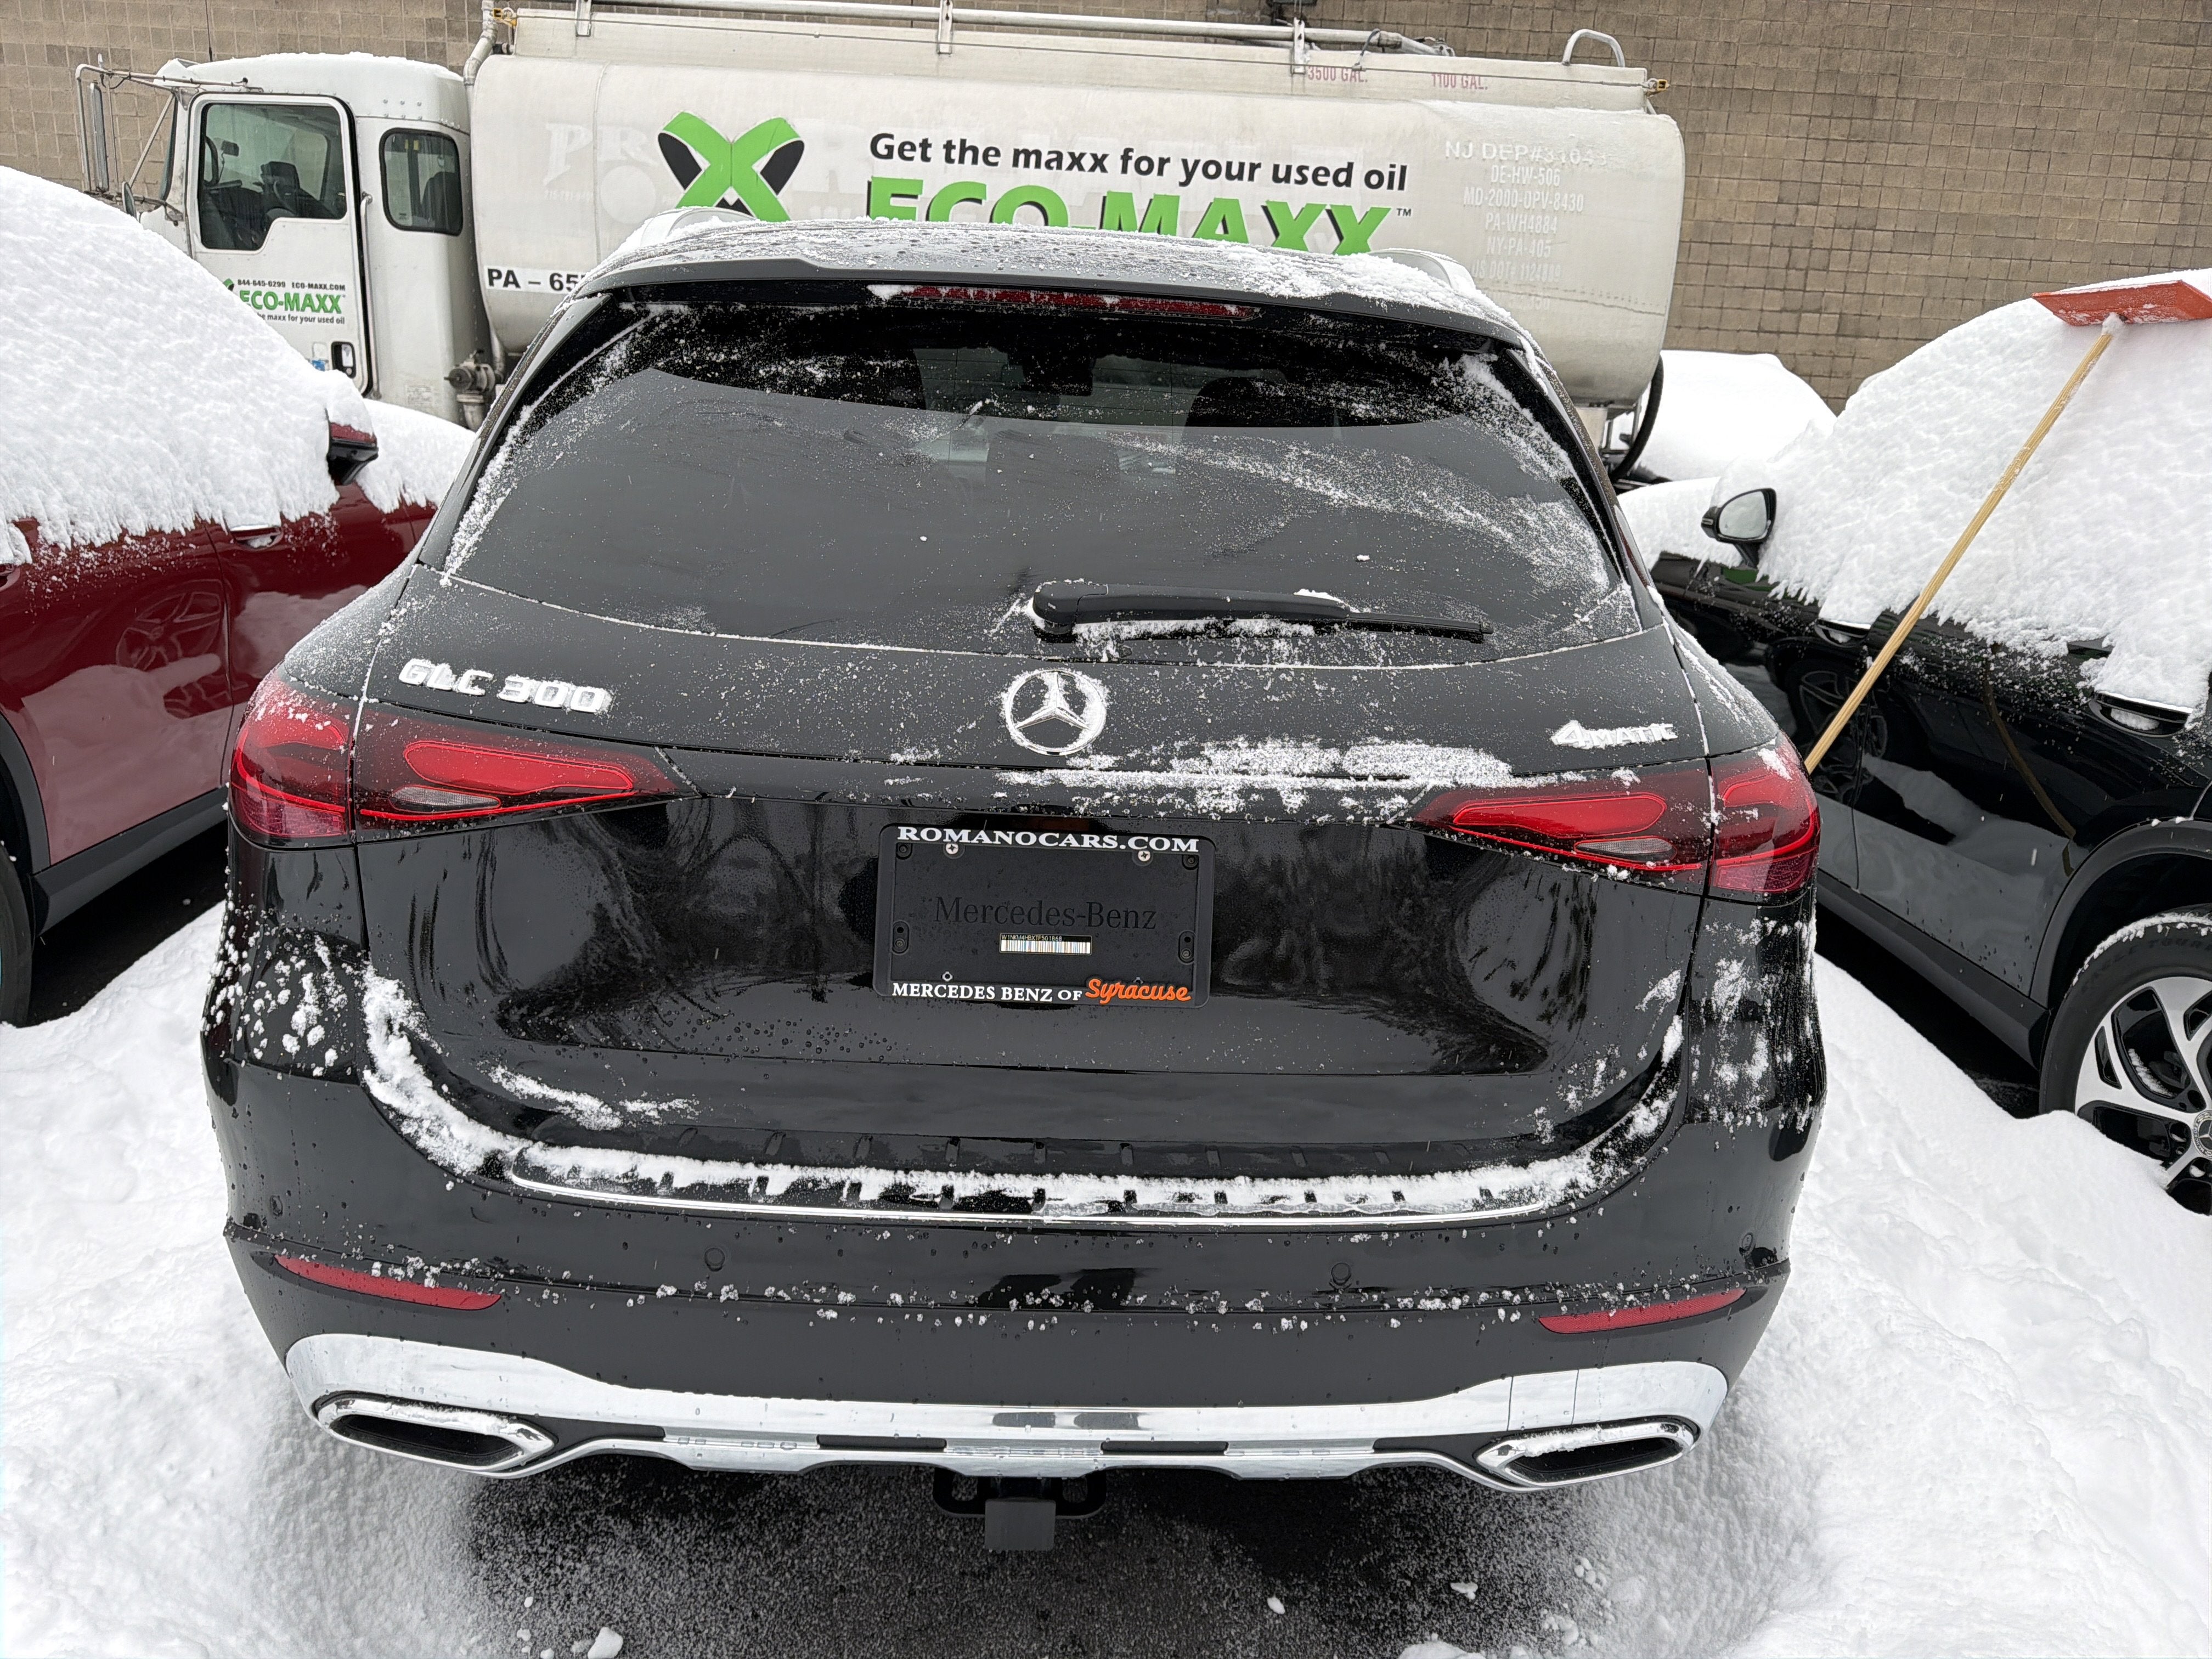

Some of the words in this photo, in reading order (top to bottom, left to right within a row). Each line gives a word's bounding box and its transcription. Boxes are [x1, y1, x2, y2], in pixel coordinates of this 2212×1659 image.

[1308, 65, 1336, 81] 3500
[1431, 72, 1457, 88] 1100
[1461, 75, 1488, 91] GAL.
[869, 132, 932, 163] Get
[943, 138, 1002, 168] the
[1011, 147, 1109, 174] maxx
[1120, 146, 1171, 177] for
[1177, 155, 1264, 187] your
[1271, 159, 1353, 189] used
[1363, 162, 1407, 191] oil
[1445, 141, 1473, 160] NJ
[1490, 165, 1561, 187] DE-HW-506
[867, 177, 1391, 256] ECOMAXX
[291, 281, 346, 291] ECO-MAXX.COM
[487, 268, 521, 289] PA
[549, 273, 588, 292] 65
[239, 290, 341, 313] ECO-MAXX
[288, 314, 298, 322] for
[300, 316, 316, 324] your
[399, 658, 494, 696] GLC
[497, 674, 614, 713] 300
[896, 826, 1200, 853] ROMANOCARS.COM
[934, 896, 1158, 930] Mercedes-Benz
[892, 983, 996, 1000] MERCEDES
[1001, 986, 1053, 1002] BENZ
[1058, 990, 1083, 1001] OF
[1085, 978, 1192, 1005] Syracuse
